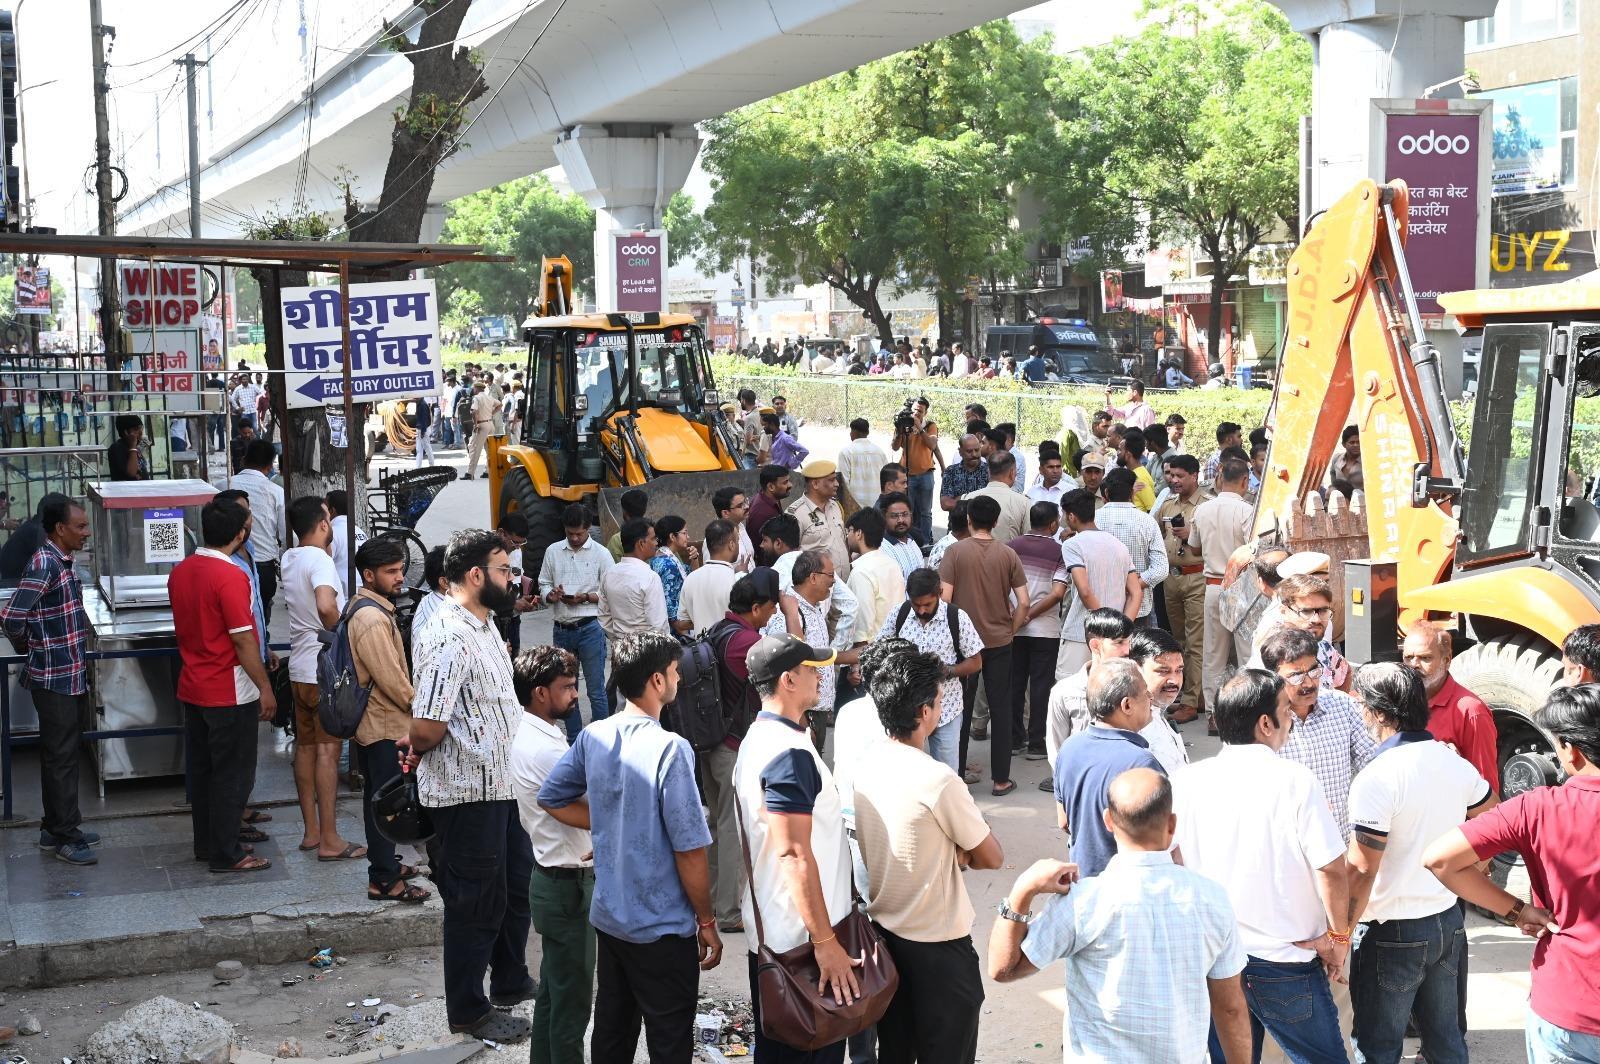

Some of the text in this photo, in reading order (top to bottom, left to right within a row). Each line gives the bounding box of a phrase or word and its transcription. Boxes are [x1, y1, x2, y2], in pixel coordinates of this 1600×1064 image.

[1398, 129, 1470, 155] odoo
[1408, 184, 1469, 198] रत का बेस्ट
[1408, 202, 1449, 217] काउंटिंग
[621, 242, 656, 255] odoo
[1070, 240, 1090, 250] RAME
[628, 258, 650, 267] CRM
[124, 268, 197, 296] WINE
[126, 299, 199, 325] SHOP
[283, 290, 430, 329] शीशम
[634, 333, 665, 345] ATHORE
[288, 326, 432, 370] फर्नीचर
[383, 375, 430, 389] OUTLET
